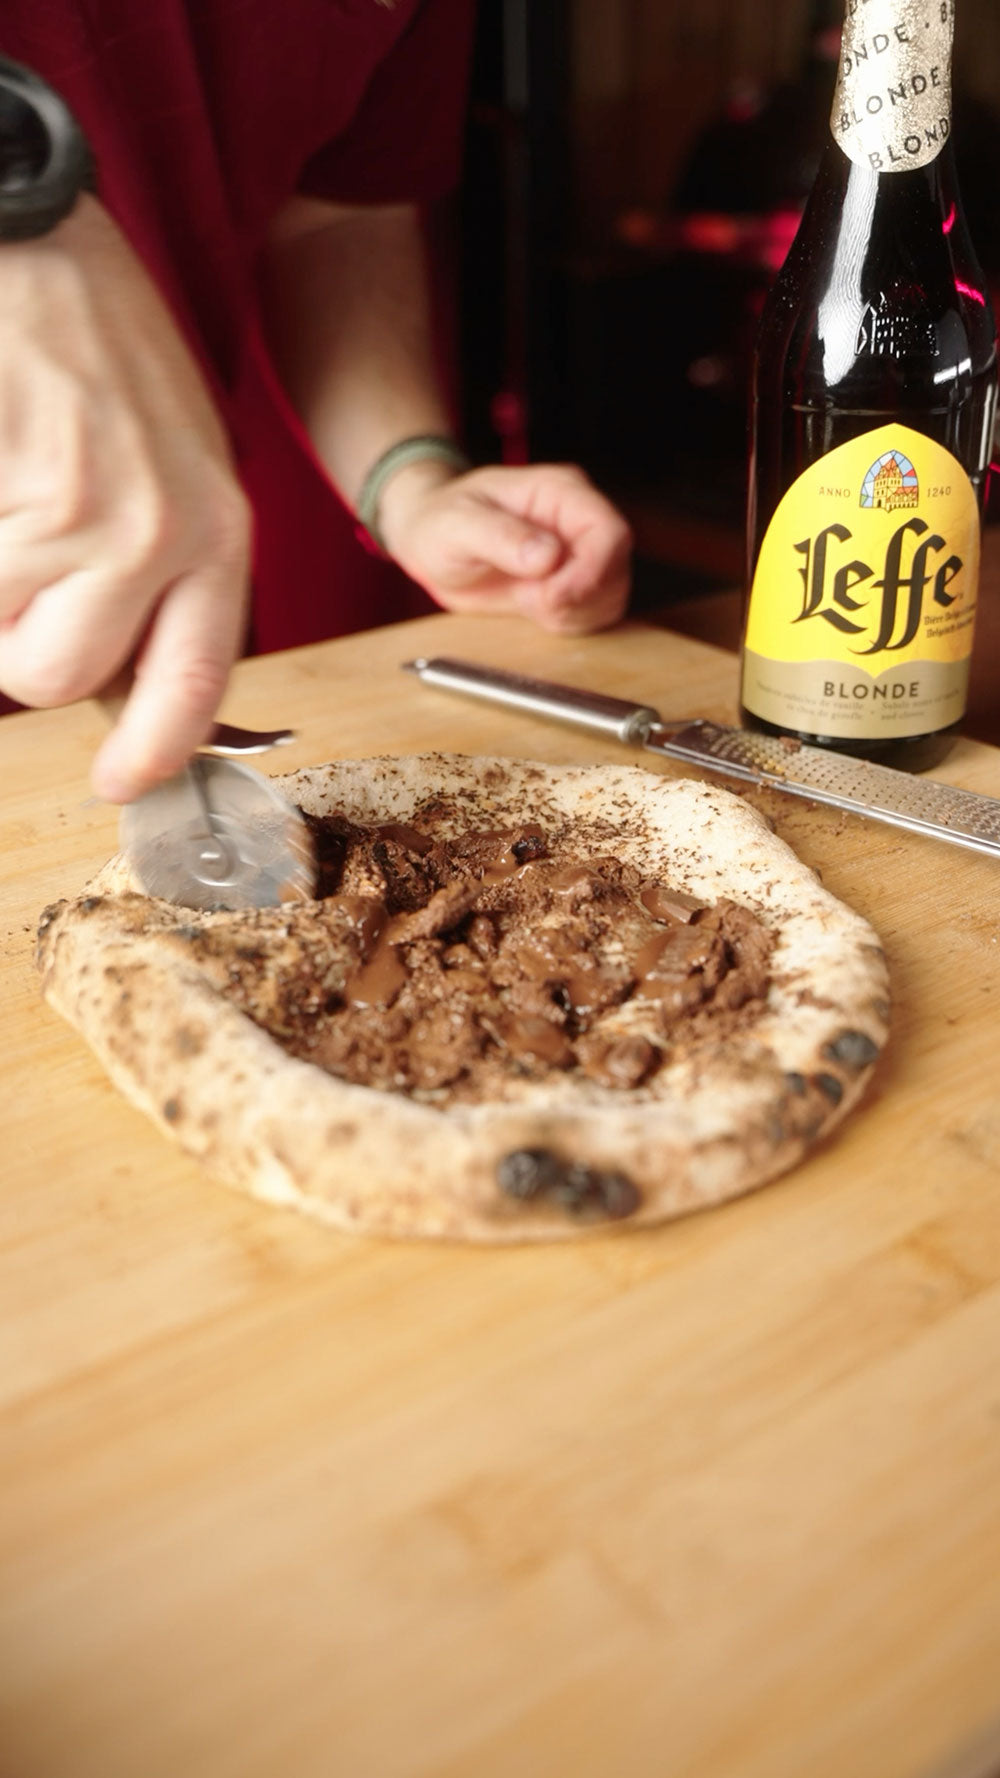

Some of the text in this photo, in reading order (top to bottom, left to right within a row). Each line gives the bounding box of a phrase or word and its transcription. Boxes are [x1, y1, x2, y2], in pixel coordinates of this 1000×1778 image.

[840, 66, 941, 132] BLONDE
[819, 486, 952, 498] ANNO 1240
[790, 517, 963, 655] Leffe
[823, 681, 920, 699] BLONDE
